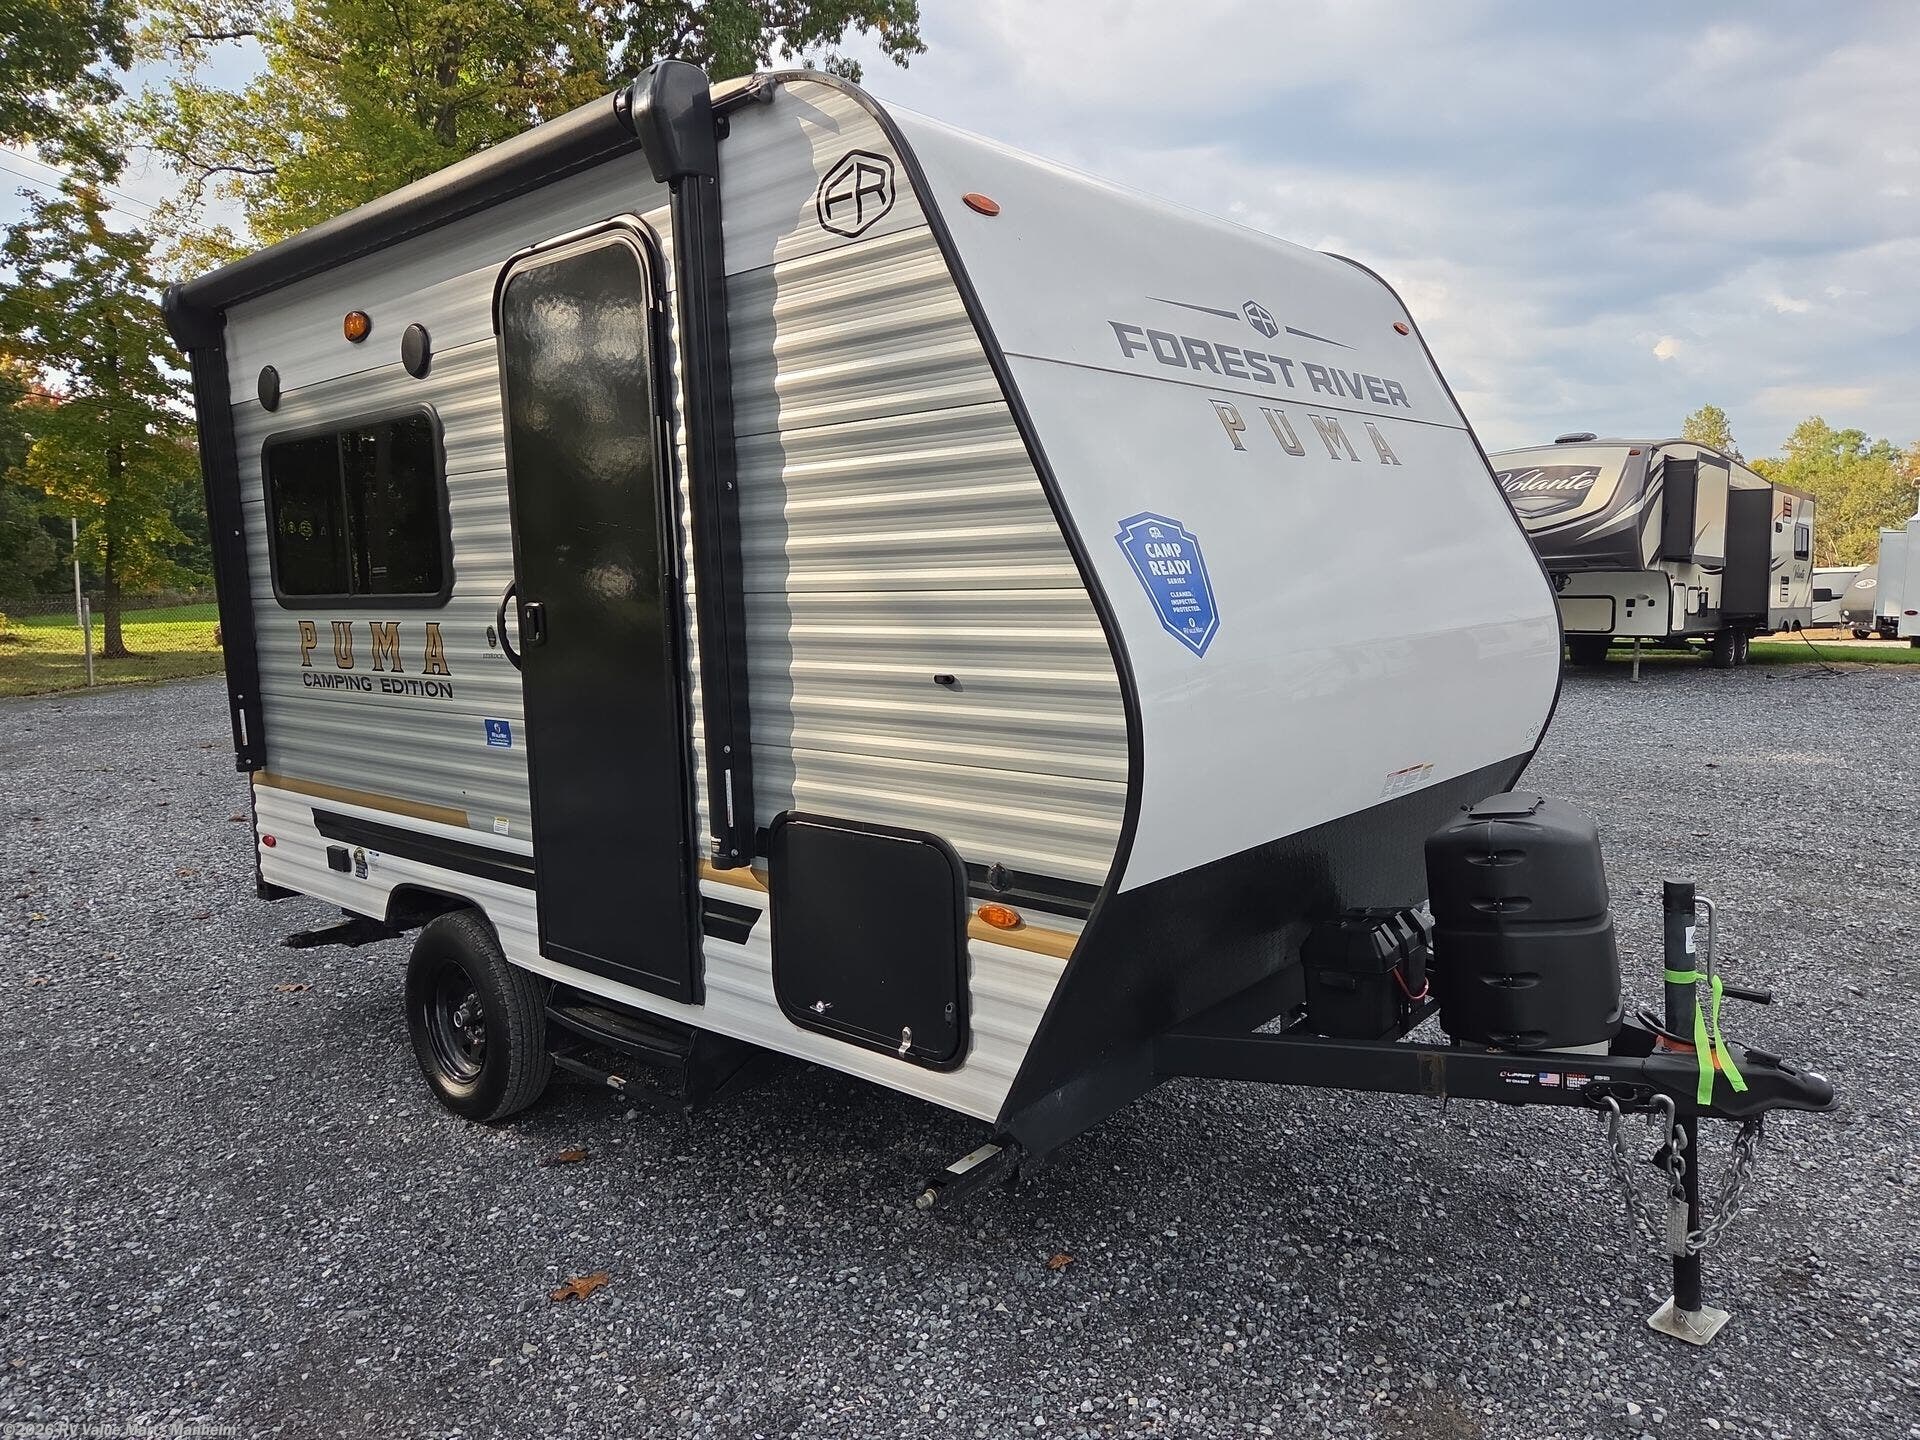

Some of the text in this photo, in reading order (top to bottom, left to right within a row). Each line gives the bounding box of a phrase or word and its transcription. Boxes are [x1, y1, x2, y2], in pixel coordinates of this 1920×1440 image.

[1108, 321, 1412, 408] FOREST RIVER
[1207, 398, 1402, 466] PUMA
[1496, 469, 1597, 493] Volante
[1145, 543, 1182, 558] CAMP
[1148, 560, 1192, 576] READY
[298, 621, 452, 676] PUMA
[303, 673, 453, 699] CAMPING EDITION
